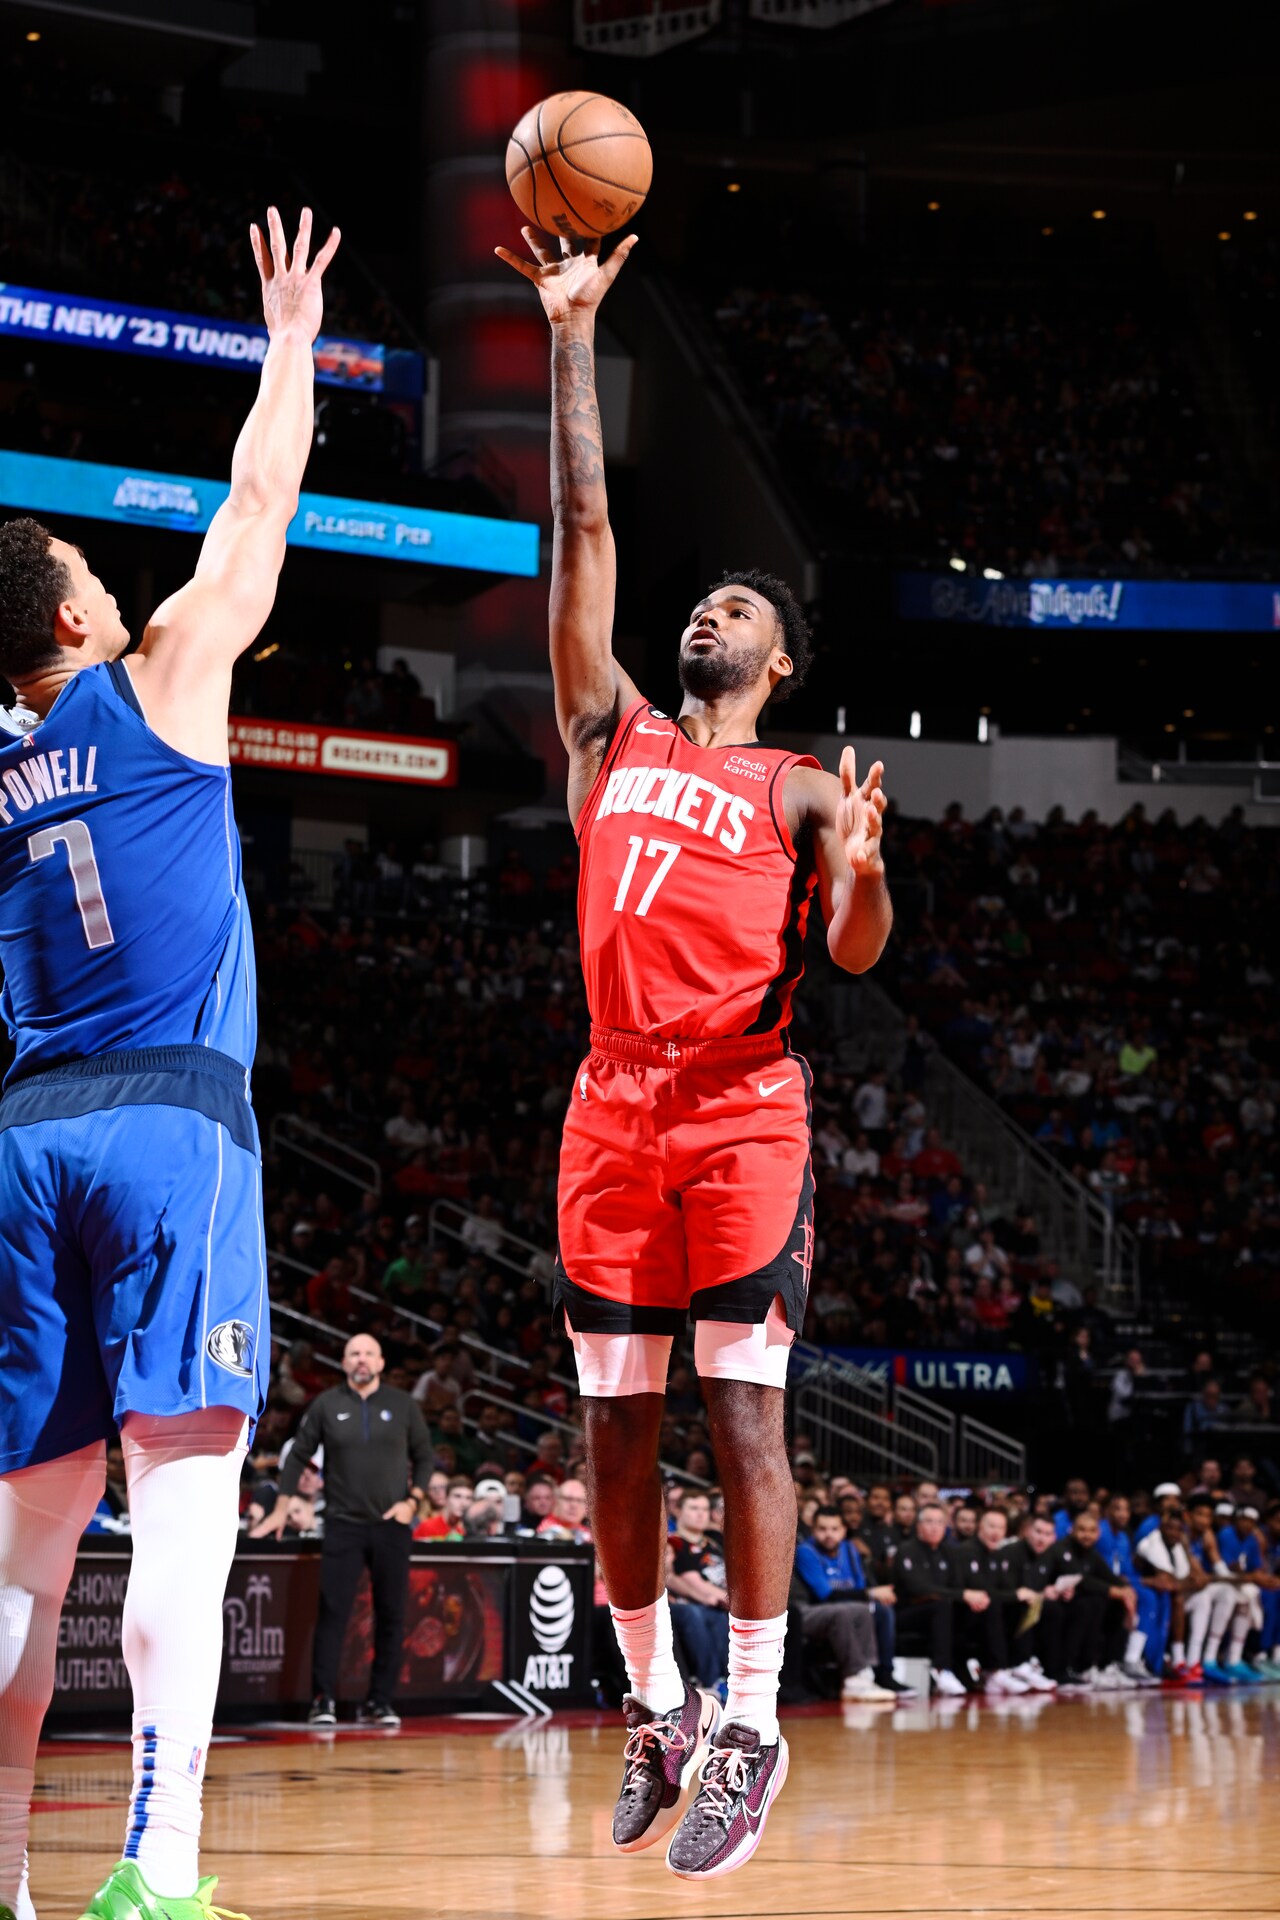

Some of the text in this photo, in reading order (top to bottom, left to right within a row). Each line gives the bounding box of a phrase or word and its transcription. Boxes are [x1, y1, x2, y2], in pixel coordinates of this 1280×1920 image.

[0, 296, 269, 363] THE NEW '23 TUNDR
[395, 523, 432, 545] PIER
[723, 761, 766, 782] karma
[730, 755, 767, 774] credit
[594, 766, 755, 854] ROCKETS
[28, 819, 115, 950] 7
[613, 835, 682, 917] 17
[914, 1361, 1014, 1391] ULTRA
[57, 1615, 122, 1649] EMORA
[223, 1574, 286, 1657] Palm
[54, 1658, 131, 1692] UTHENT
[523, 1653, 575, 1690] AT&T
